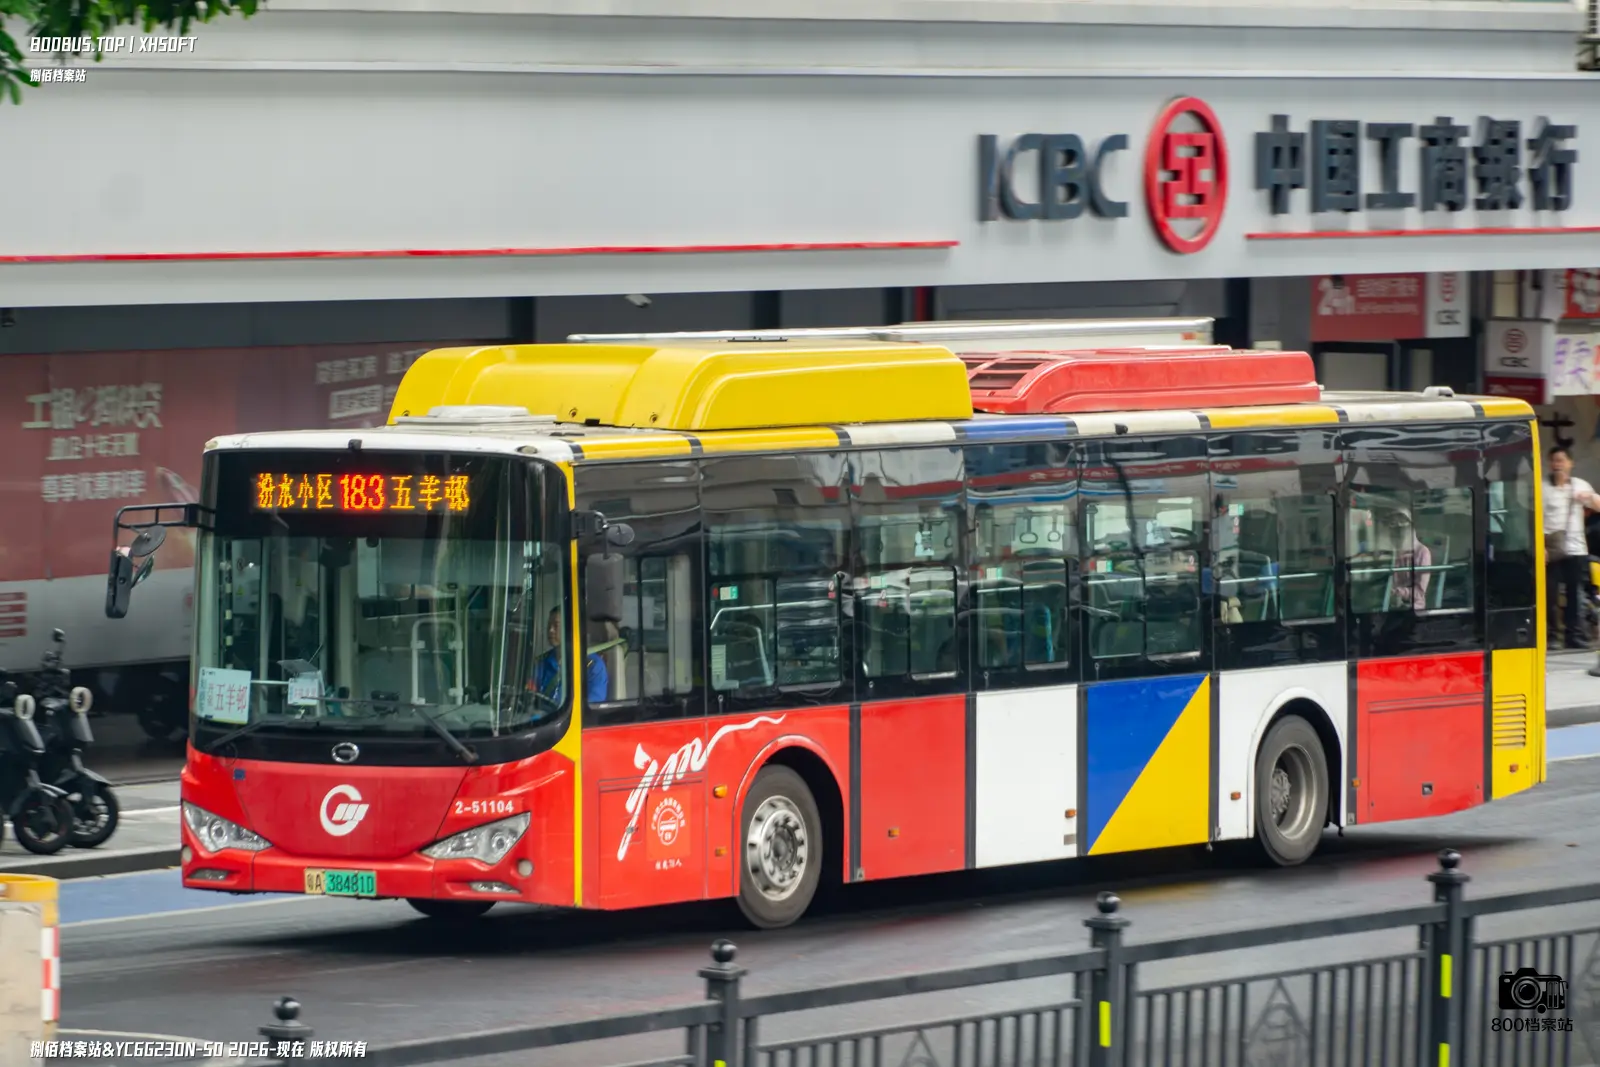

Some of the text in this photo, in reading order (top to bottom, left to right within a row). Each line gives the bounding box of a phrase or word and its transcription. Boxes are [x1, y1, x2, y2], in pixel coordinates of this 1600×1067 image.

[978, 132, 1129, 222] ICBC
[1254, 113, 1579, 215] 中国工商银行
[339, 473, 385, 510] 183
[455, 800, 514, 815] 2-51104
